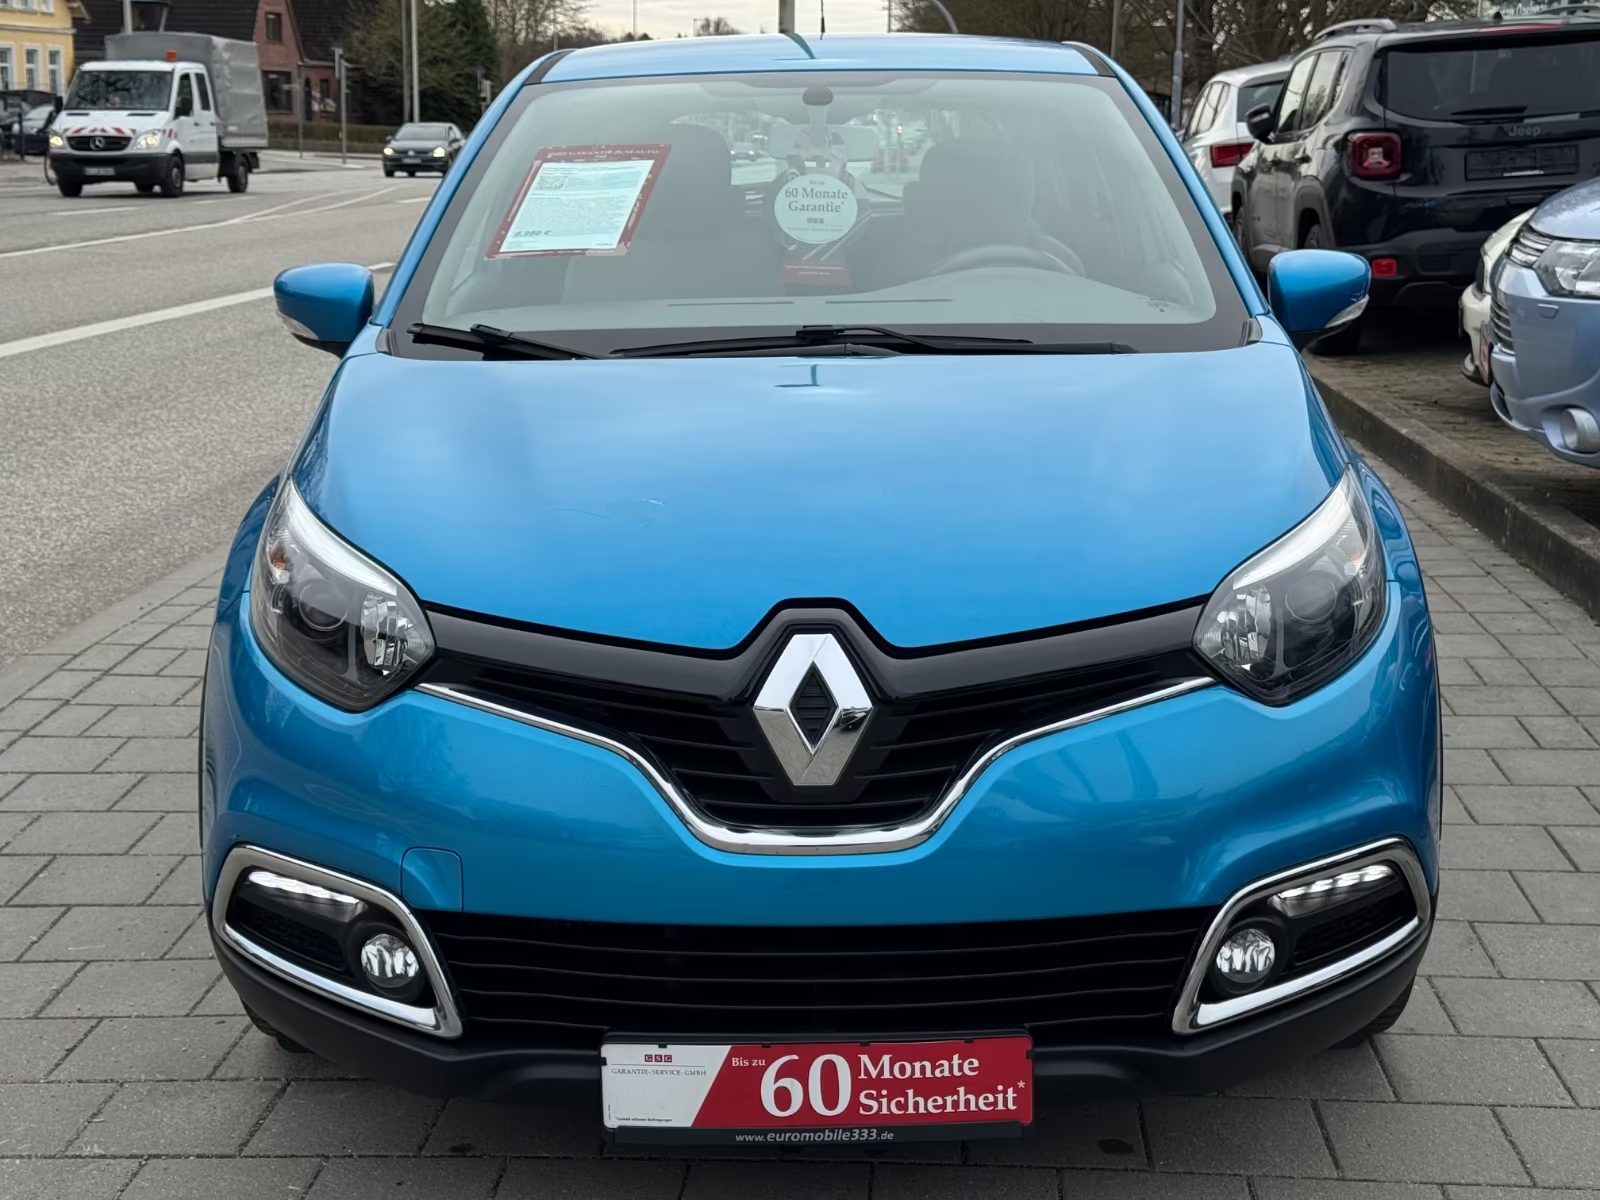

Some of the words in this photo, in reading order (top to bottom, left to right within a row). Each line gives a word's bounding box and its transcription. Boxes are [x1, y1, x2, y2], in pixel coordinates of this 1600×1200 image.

[1508, 126, 1541, 137] Jeep
[785, 187, 798, 198] 60
[802, 187, 848, 199] Monate
[644, 1054, 672, 1063] GSG
[731, 1057, 749, 1067] Bis
[752, 1058, 766, 1066] zu
[857, 1053, 980, 1079] Monate
[760, 1053, 852, 1118] 60
[735, 1128, 894, 1142] www.euromobile333.de
